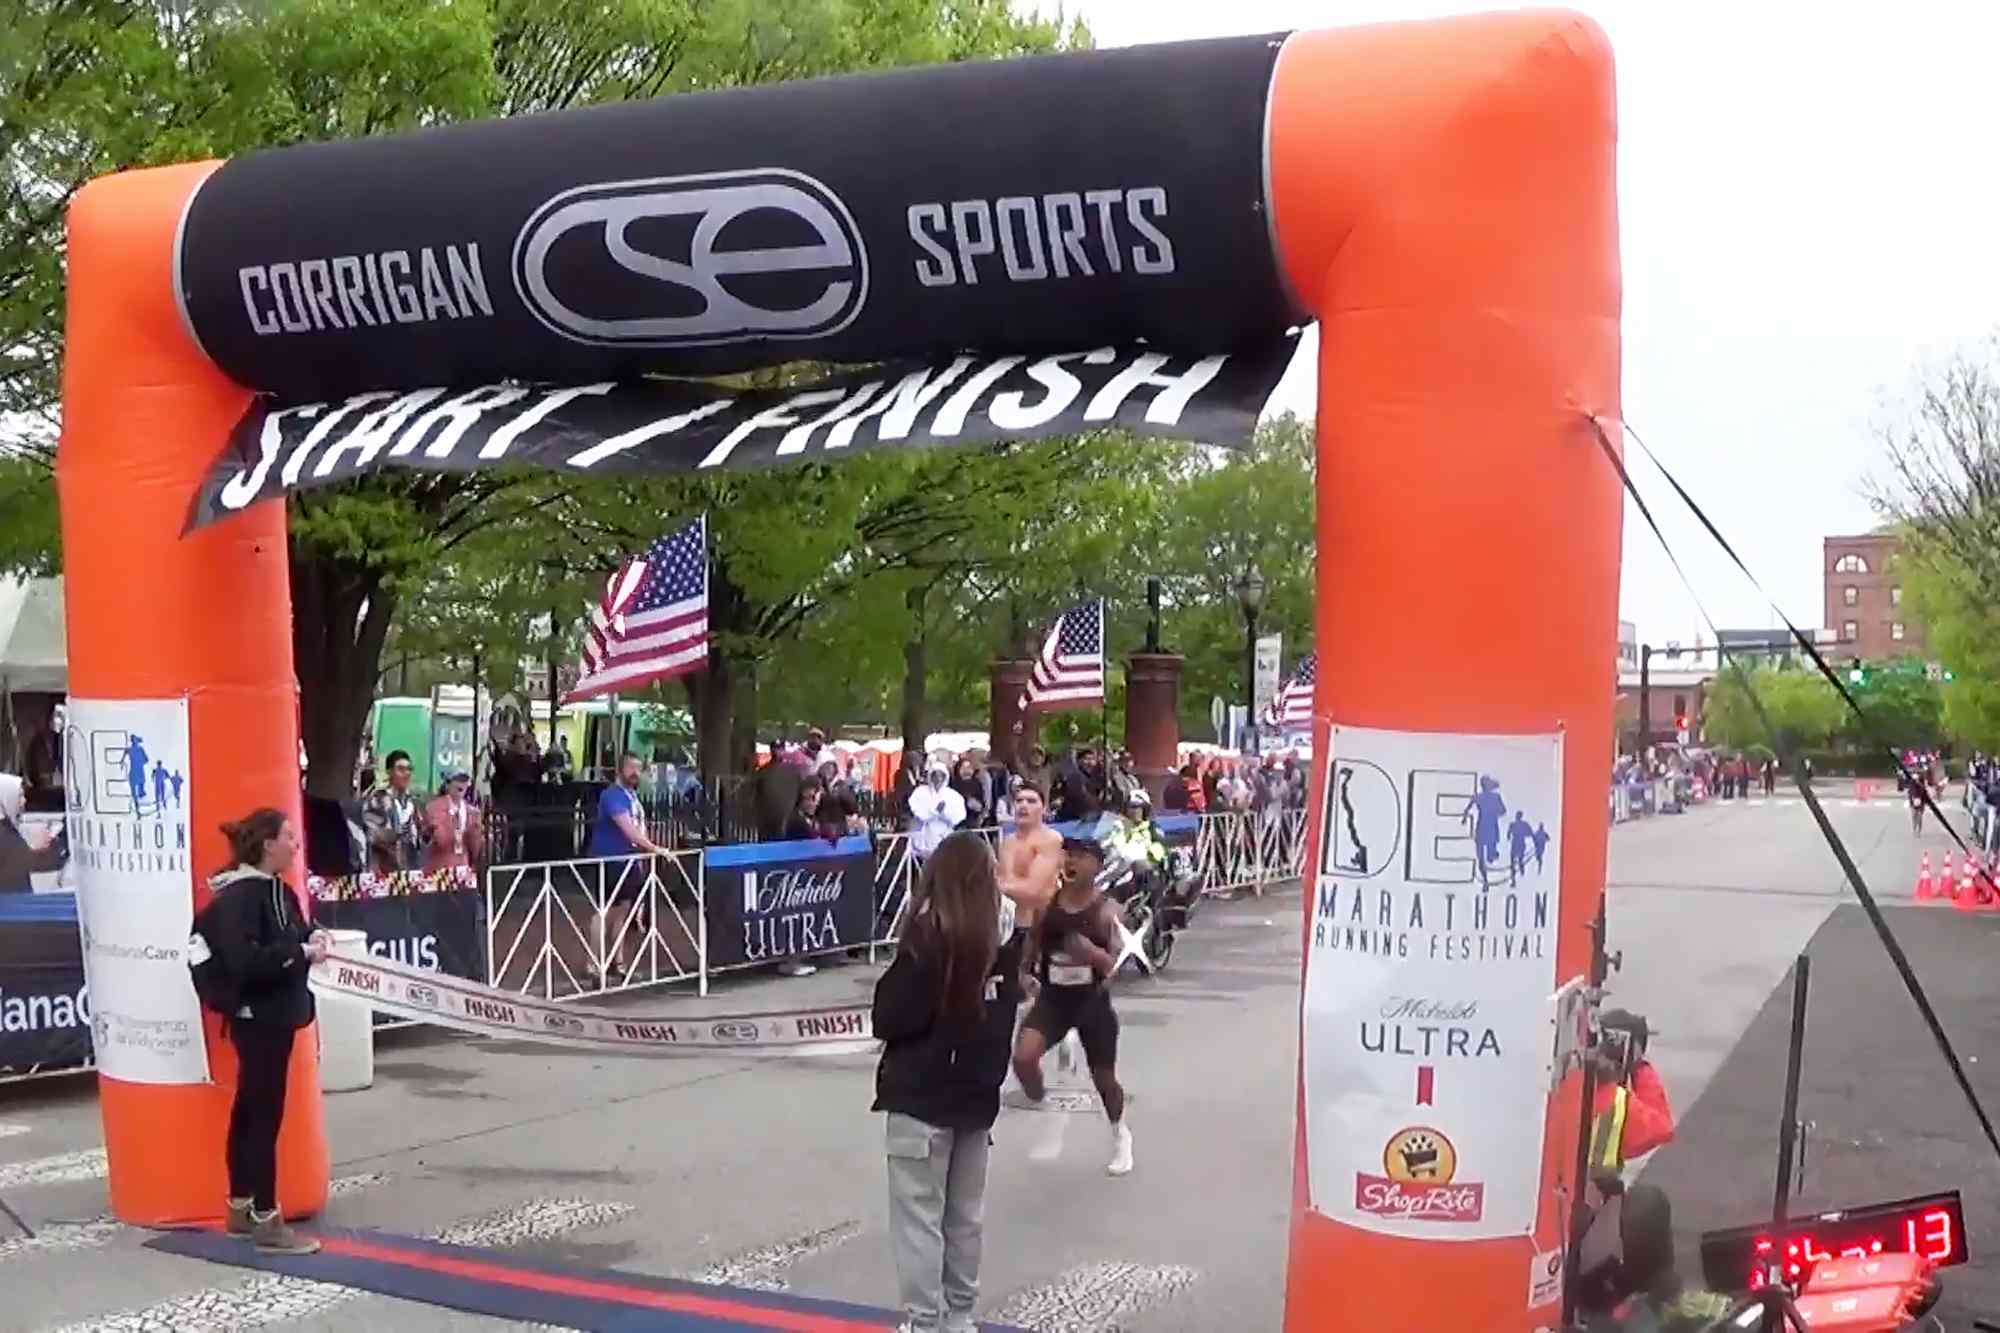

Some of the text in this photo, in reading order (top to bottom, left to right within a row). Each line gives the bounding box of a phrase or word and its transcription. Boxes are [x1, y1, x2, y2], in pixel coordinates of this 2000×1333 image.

[239, 187, 1175, 335] CORRIGAN SPORTS
[221, 381, 618, 509] START
[698, 346, 1231, 469] FINISH
[1318, 883, 1549, 930] MARATHON
[743, 909, 839, 960] ULTRA
[1316, 923, 1545, 961] RUNNING FESTIVAL
[337, 966, 381, 994] FINISH
[465, 997, 517, 1025] FINISH
[614, 1012, 677, 1042] FINISH
[796, 1004, 864, 1038] FINISH
[1360, 1021, 1501, 1057] ULTRA
[1361, 1182, 1477, 1215] ShopRite
